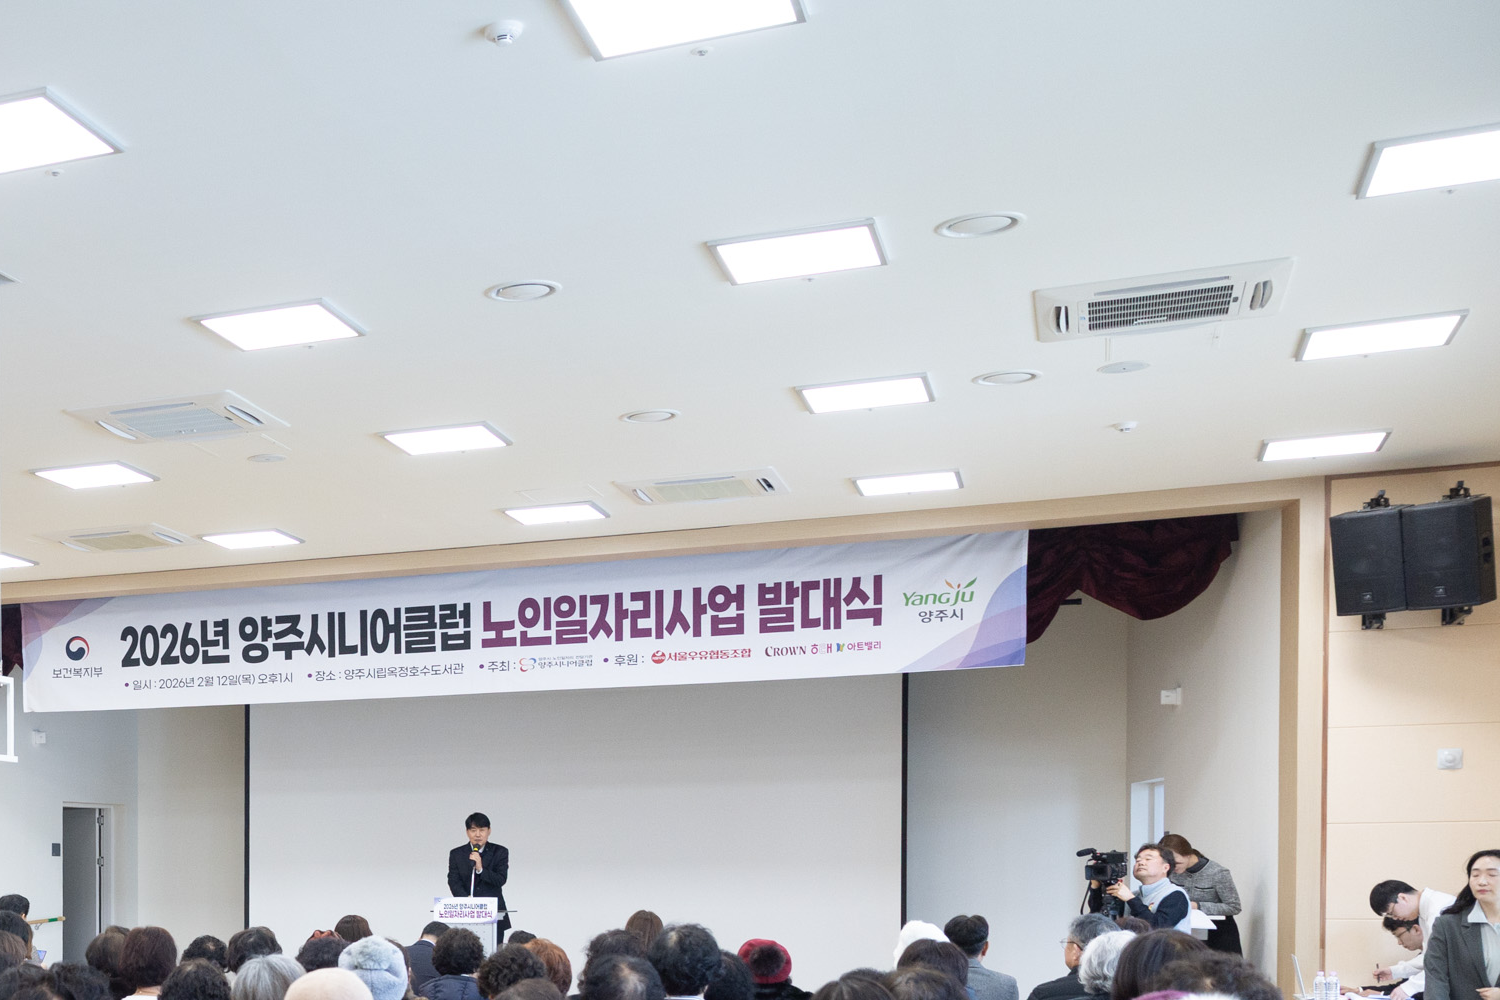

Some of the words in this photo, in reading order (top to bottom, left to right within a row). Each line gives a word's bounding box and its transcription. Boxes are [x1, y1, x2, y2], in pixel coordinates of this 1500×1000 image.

[120, 618, 230, 668] 2026년
[238, 602, 472, 664] 양주시니어클럽
[481, 584, 745, 648] 노인일자리사업
[757, 574, 883, 634] 발대식
[918, 608, 964, 624] 양주시
[847, 641, 882, 651] 아트밸리
[614, 654, 638, 666] 후원
[667, 648, 752, 662] 서울우유협동조합
[52, 667, 103, 679] 보건복지부
[315, 670, 336, 682] 장소
[344, 663, 464, 680] 양주시립옥정호수도서관
[487, 661, 510, 672] 주최
[132, 679, 152, 690] 일시
[159, 676, 195, 689] 2026년
[197, 676, 214, 688] 2월
[216, 673, 256, 686] 12일(목)
[258, 672, 293, 684] 오후1시
[439, 910, 475, 918] 노인일자리사업
[476, 910, 492, 918] 발대식
